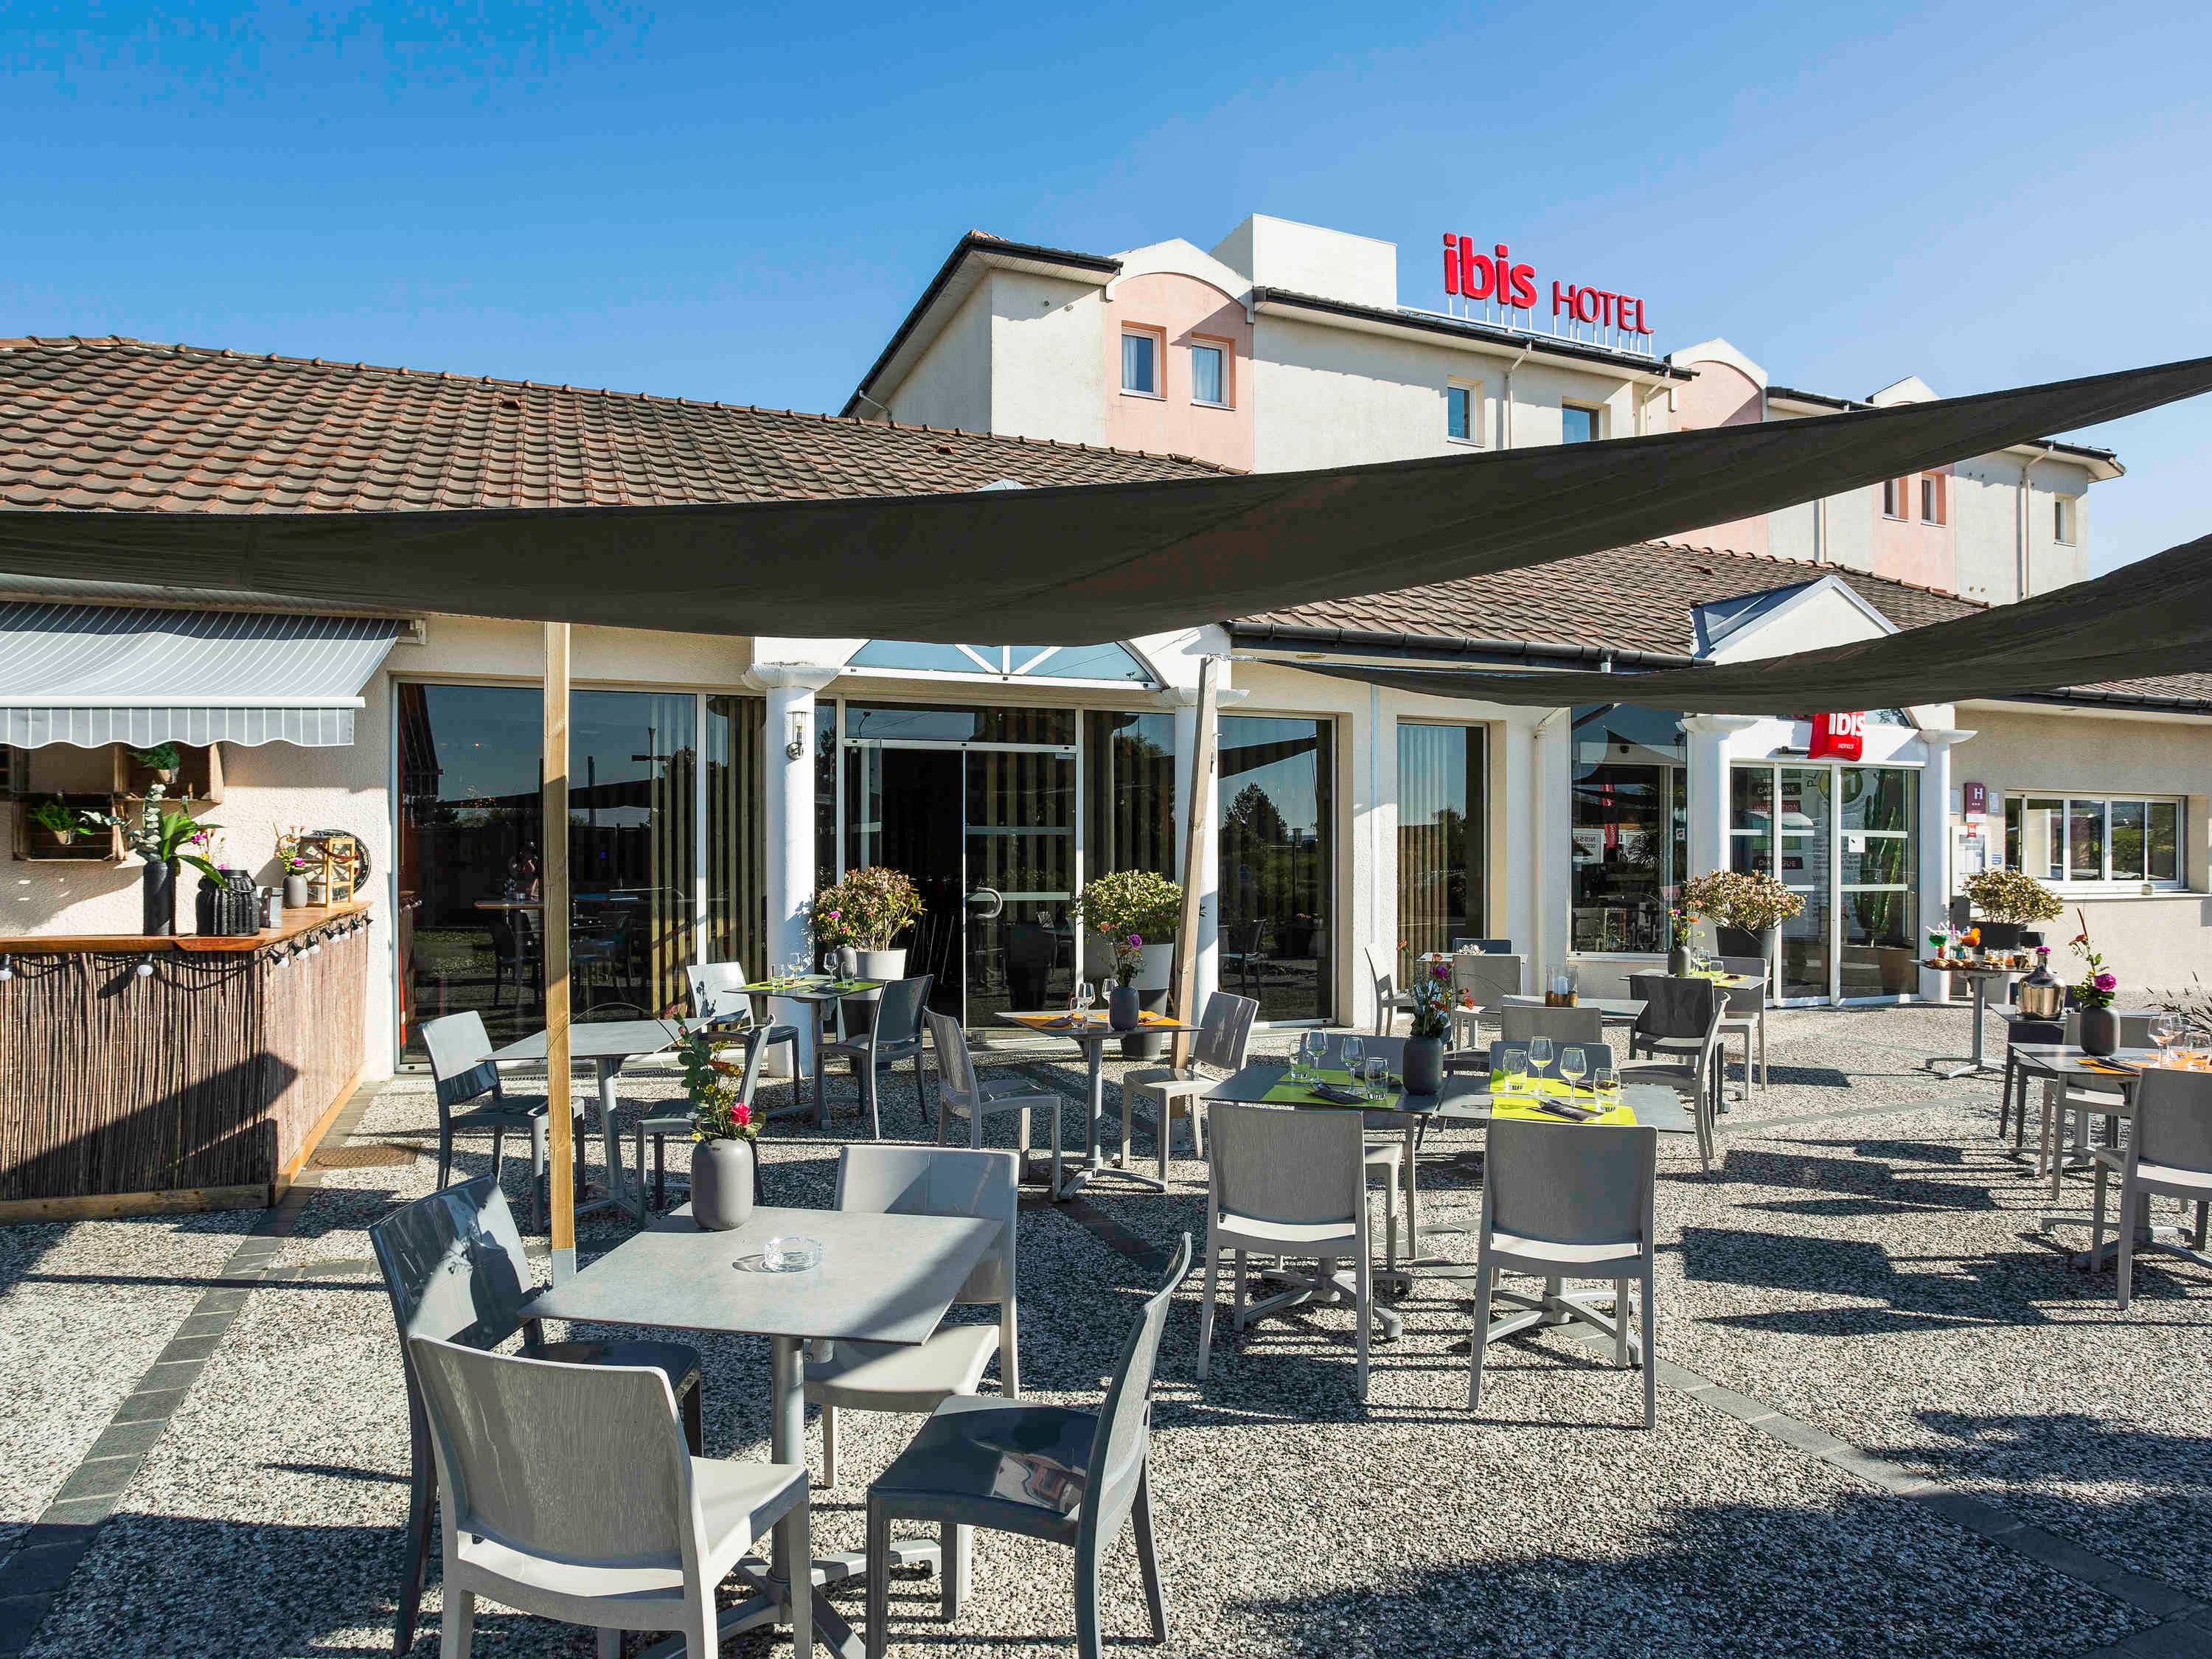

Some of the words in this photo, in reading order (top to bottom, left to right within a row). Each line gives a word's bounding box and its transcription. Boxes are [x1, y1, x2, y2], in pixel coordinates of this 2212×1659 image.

[1443, 232, 1538, 309] ibis
[1552, 279, 1655, 334] HOTEL
[1974, 787, 1983, 799] H
